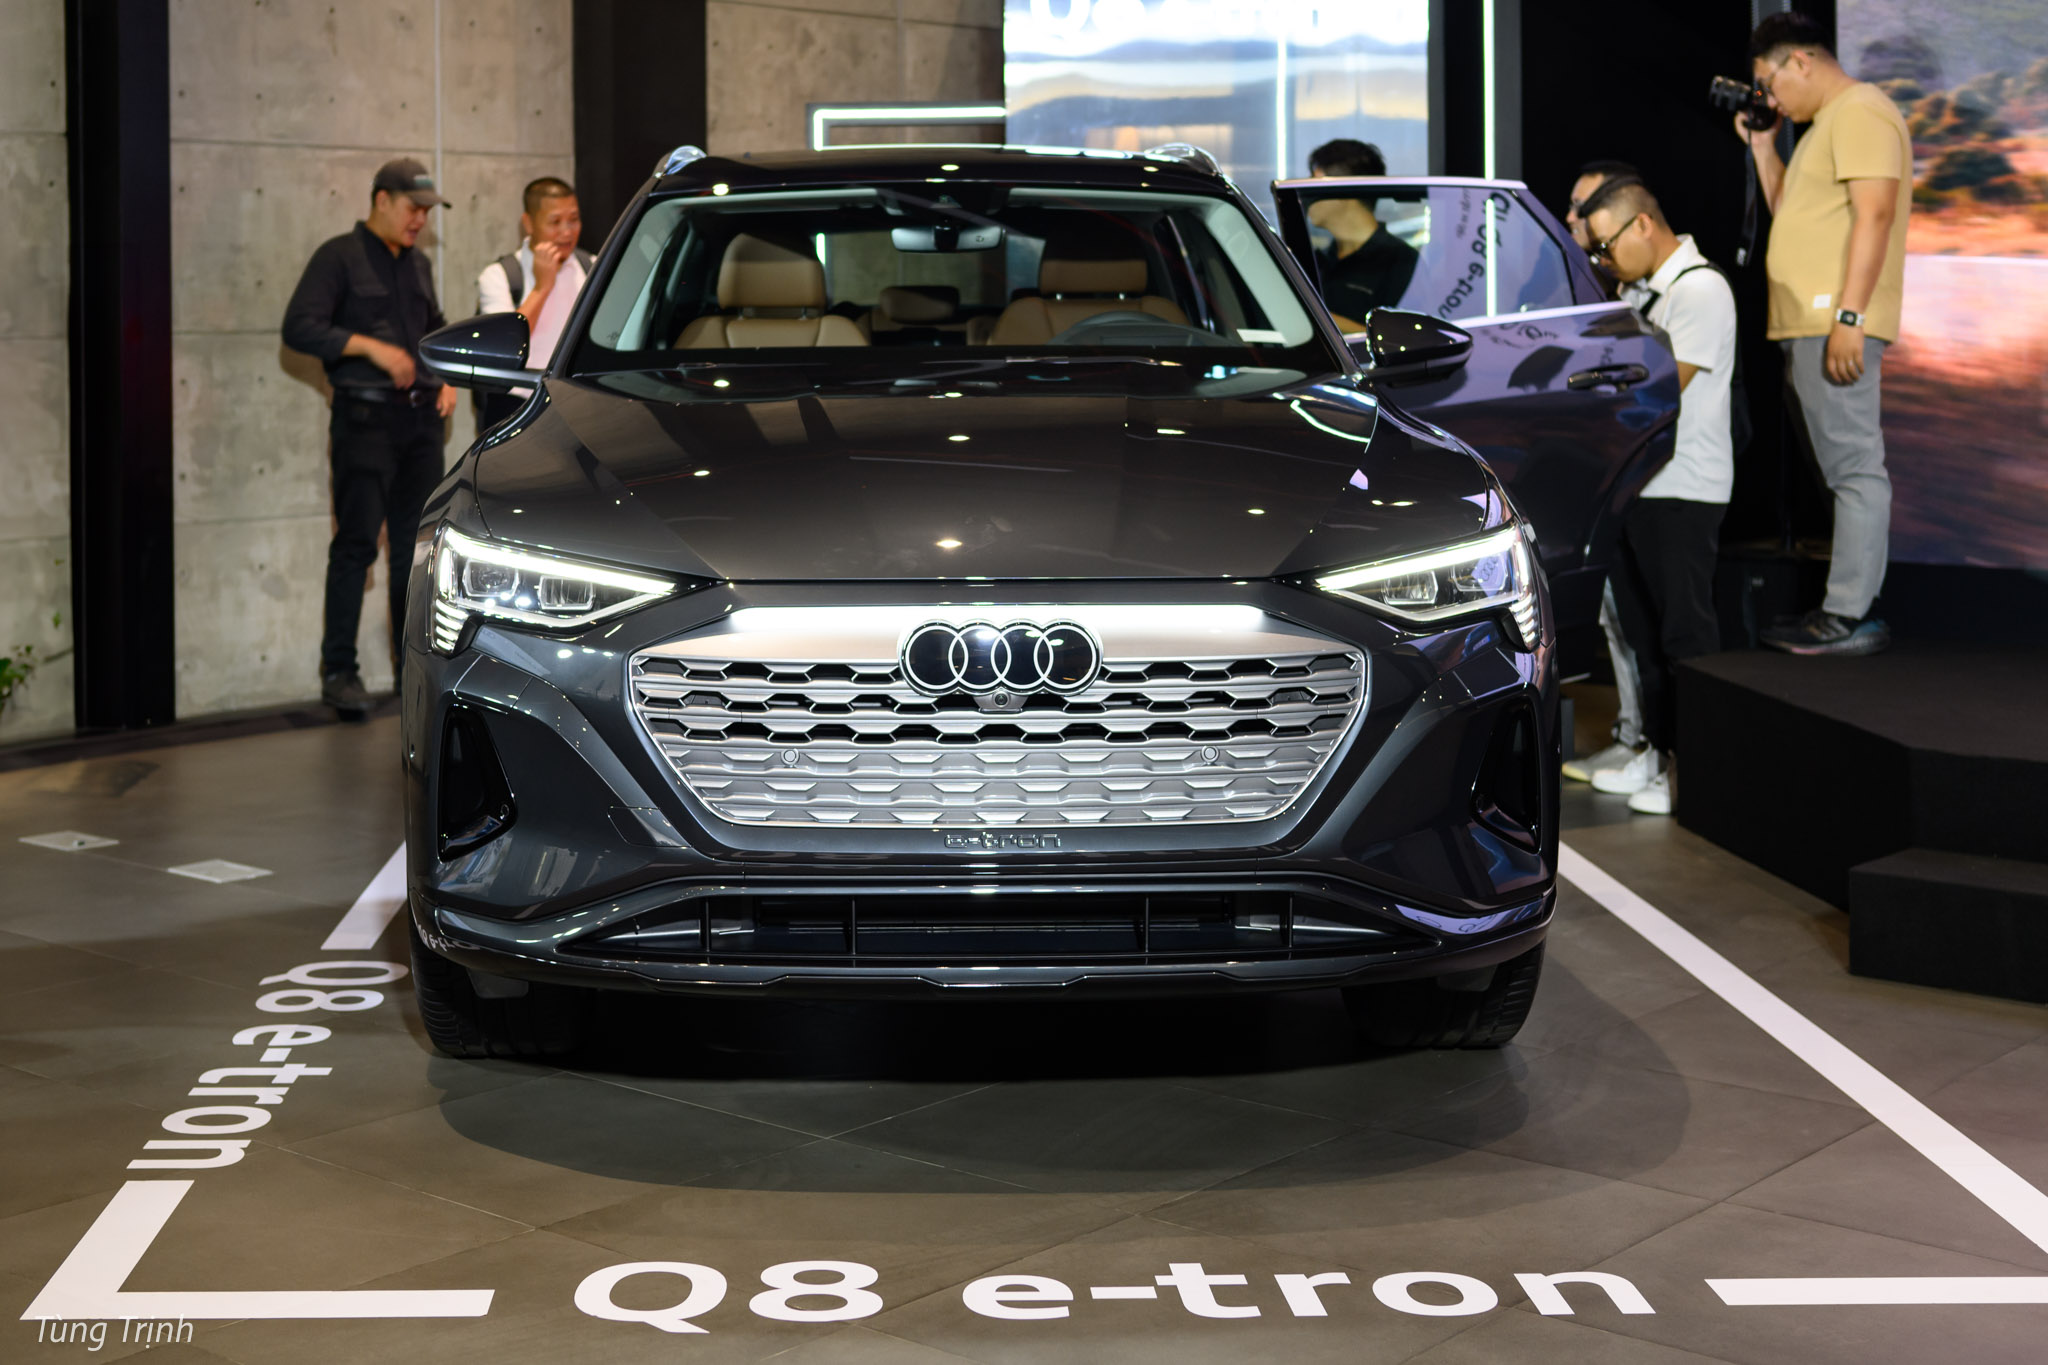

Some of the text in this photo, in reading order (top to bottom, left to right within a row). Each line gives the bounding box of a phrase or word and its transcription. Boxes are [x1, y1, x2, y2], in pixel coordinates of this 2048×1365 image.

[944, 831, 1061, 849] e-tron
[127, 960, 409, 1169] Q8 e-tron
[574, 1261, 1657, 1334] Q8 e-tron
